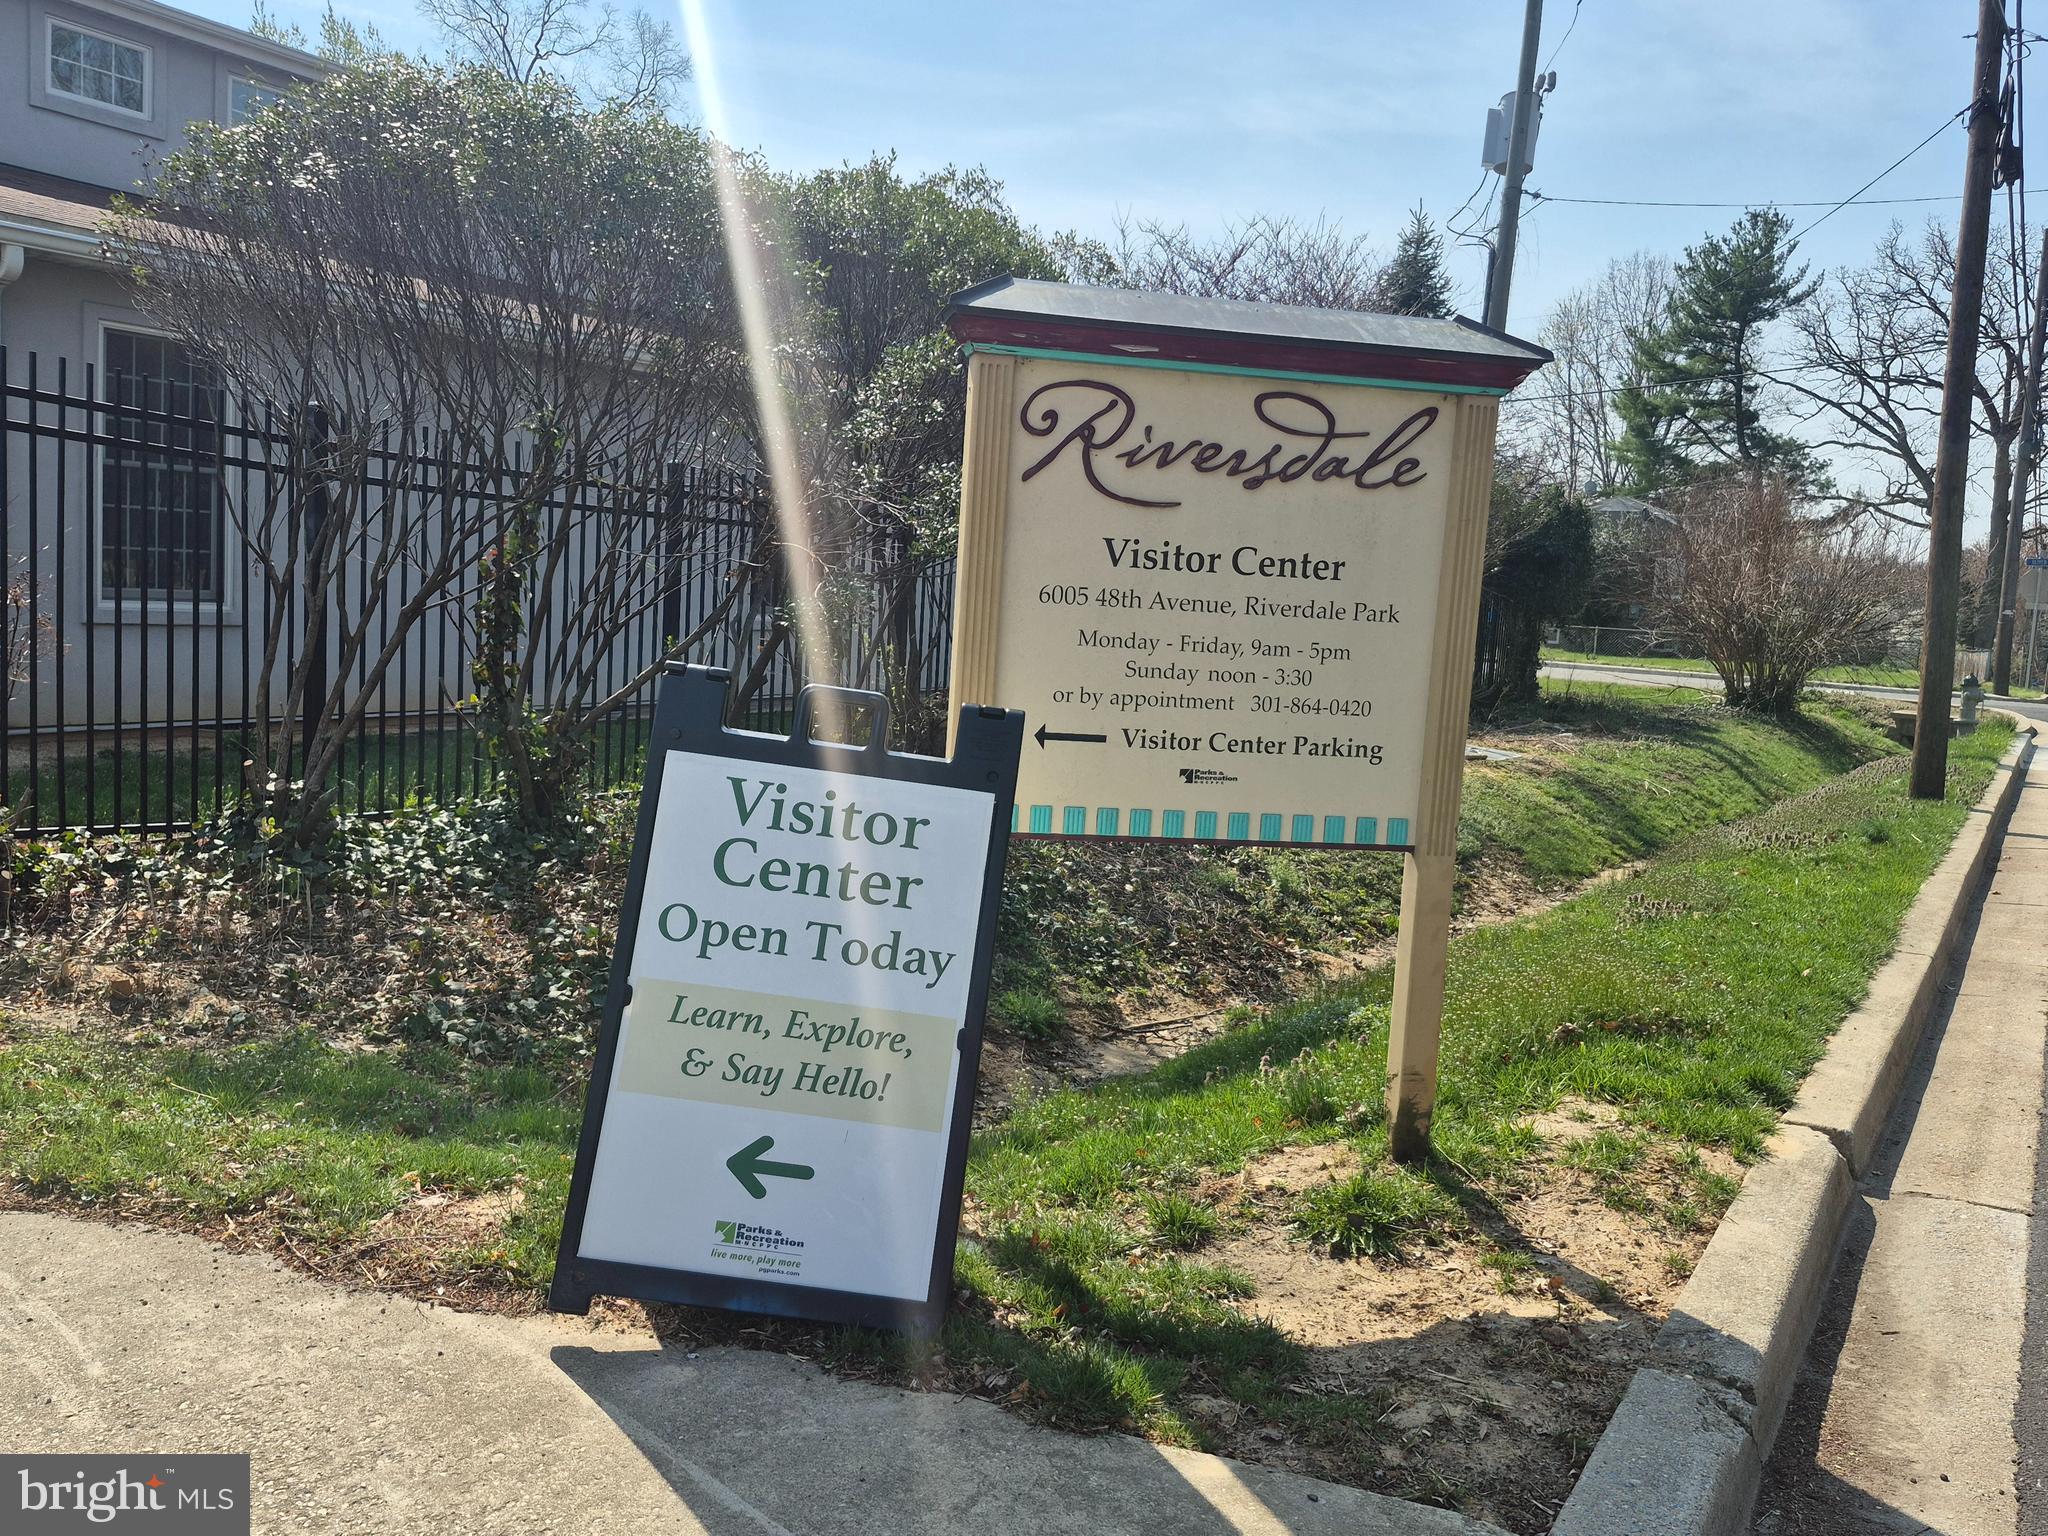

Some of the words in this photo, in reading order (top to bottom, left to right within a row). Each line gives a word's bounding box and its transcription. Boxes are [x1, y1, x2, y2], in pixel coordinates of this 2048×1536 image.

[1020, 379, 1440, 508] Riversdale
[1102, 537, 1222, 574] Visitor
[1231, 546, 1347, 582] Center
[1038, 584, 1090, 606] 6005
[1094, 587, 1143, 610] 48th
[1147, 591, 1237, 618] Avenue,
[1243, 596, 1347, 621] Riverdale
[1352, 602, 1400, 624] Park
[1076, 629, 1161, 657] Monday
[1179, 635, 1244, 661] Friday,
[1250, 638, 1291, 658] 9am
[1309, 642, 1351, 665] 5pm
[1124, 660, 1200, 687] Sunday
[1207, 669, 1257, 684] noon
[1274, 668, 1313, 687] 3:30
[1052, 690, 1075, 703] or
[1079, 686, 1104, 711] by
[1109, 690, 1236, 713] appointment
[1250, 695, 1373, 718] 301-864-0420
[1121, 728, 1202, 752] Visitor
[1208, 732, 1287, 756] Center
[1292, 736, 1384, 766] Parking
[726, 776, 930, 850] Visitor
[713, 837, 924, 911] Center
[657, 902, 789, 960] Open
[805, 919, 957, 990] Today
[667, 994, 771, 1042] Learn,
[781, 1010, 914, 1059] Explore,
[680, 1047, 714, 1078] &
[721, 1052, 785, 1097] Say
[791, 1061, 892, 1102] Hello!
[735, 1231, 805, 1248] Recreation
[737, 1223, 773, 1236] Parks
[711, 1247, 728, 1259] live
[729, 1252, 755, 1265] more,
[756, 1254, 777, 1267] play
[778, 1259, 801, 1268] more
[758, 1267, 800, 1277] pgparks.com
